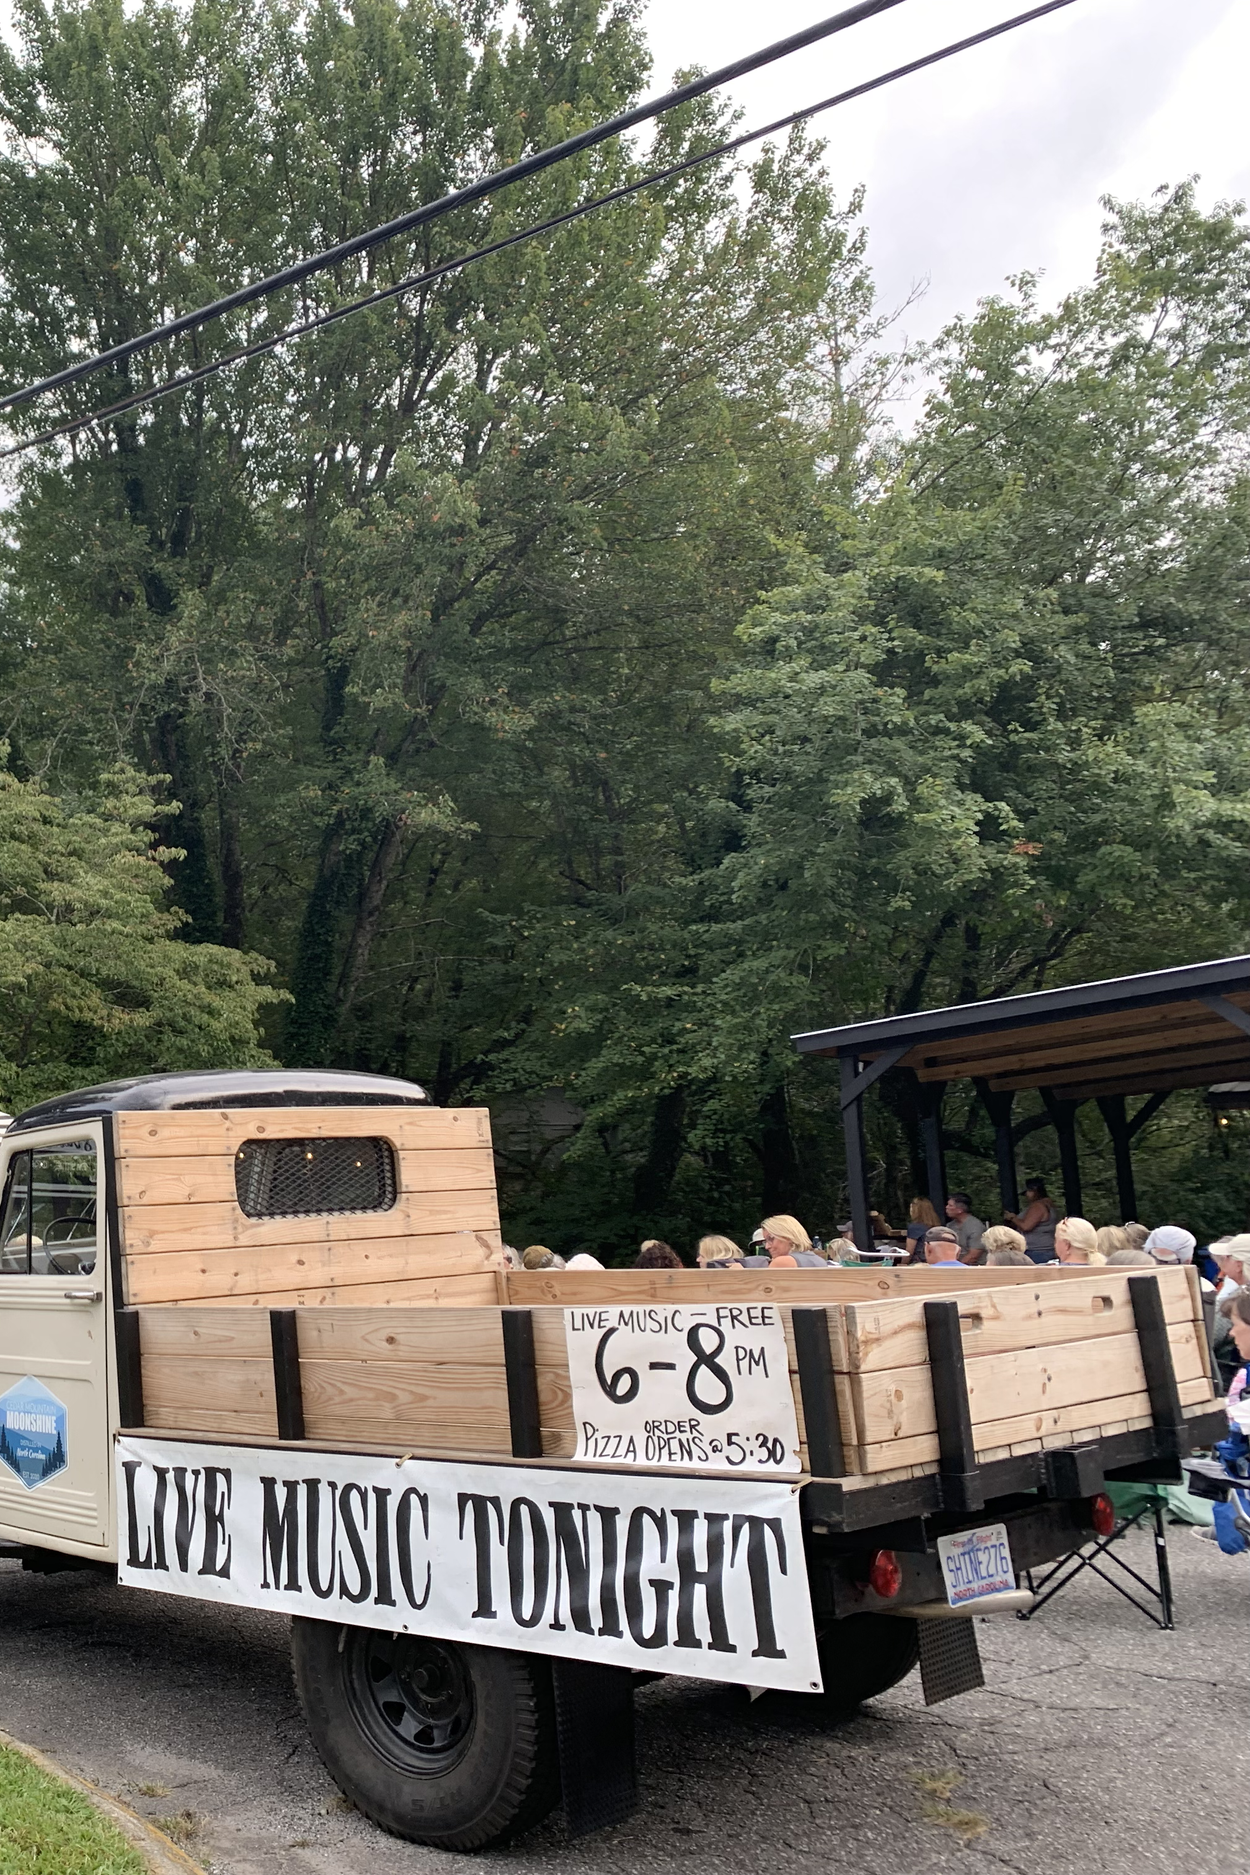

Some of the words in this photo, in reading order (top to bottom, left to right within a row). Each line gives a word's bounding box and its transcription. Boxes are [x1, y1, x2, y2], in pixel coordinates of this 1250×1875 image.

[571, 1310, 610, 1332] LIVE
[715, 1306, 775, 1330] FREE
[734, 1346, 770, 1378] PM
[6, 1410, 57, 1435] MOONSHINE
[644, 1418, 704, 1437] ORDER
[645, 1435, 709, 1463] OPENS
[121, 1460, 232, 1580] LIVE
[260, 1475, 432, 1611] MUSIC
[457, 1491, 787, 1660] TONIGHT
[946, 1542, 1010, 1588] SHINE276
